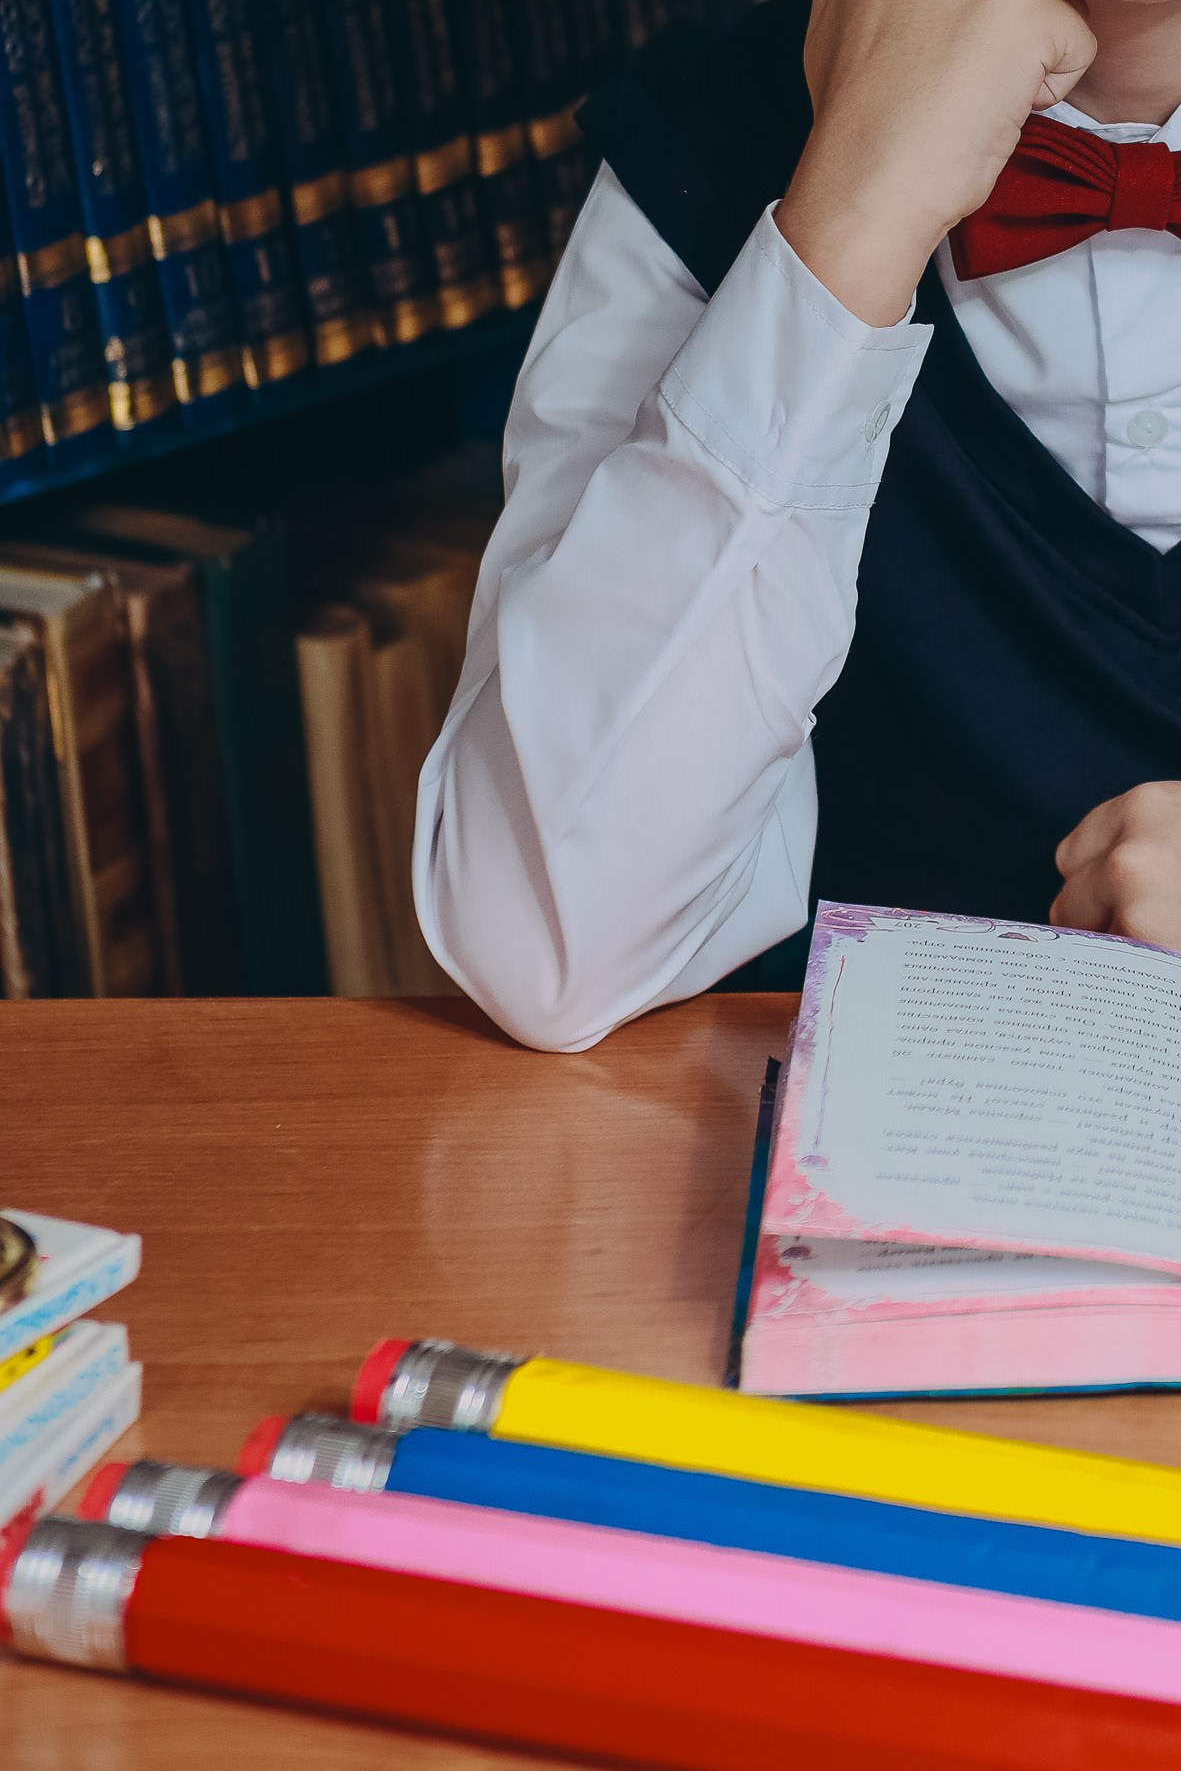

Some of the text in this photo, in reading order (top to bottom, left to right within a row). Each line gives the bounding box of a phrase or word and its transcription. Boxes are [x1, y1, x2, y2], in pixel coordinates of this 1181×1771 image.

[893, 919, 921, 929] 207
[903, 951, 993, 964] немедленно
[952, 944, 1051, 959] собственным
[902, 963, 993, 976] осколочных
[999, 960, 1028, 968] они
[1033, 964, 1059, 973] что
[1000, 972, 1043, 981] видел
[899, 986, 981, 998] единороги
[1024, 986, 1072, 997] грибы
[1077, 982, 1135, 997] никогда
[987, 994, 1013, 1002] как
[897, 998, 990, 1011] осколочные
[1049, 1001, 1104, 1015] такими
[1080, 995, 1155, 1014] летающие
[896, 1011, 984, 1023] количество
[997, 1008, 1056, 1019] считала
[992, 1020, 1068, 1033] огромное
[1064, 1016, 1096, 1027] Она
[946, 1027, 987, 1037] когда
[962, 1041, 1031, 1054] ужасном
[1065, 1029, 1168, 1054] разбивается
[925, 1051, 996, 1063] слышать
[1038, 1049, 1076, 1059] этом
[1078, 1043, 1141, 1059] которое
[1009, 1059, 1065, 1071] только
[1108, 1061, 1154, 1076] бурях
[1078, 1068, 1170, 1091] доводилось
